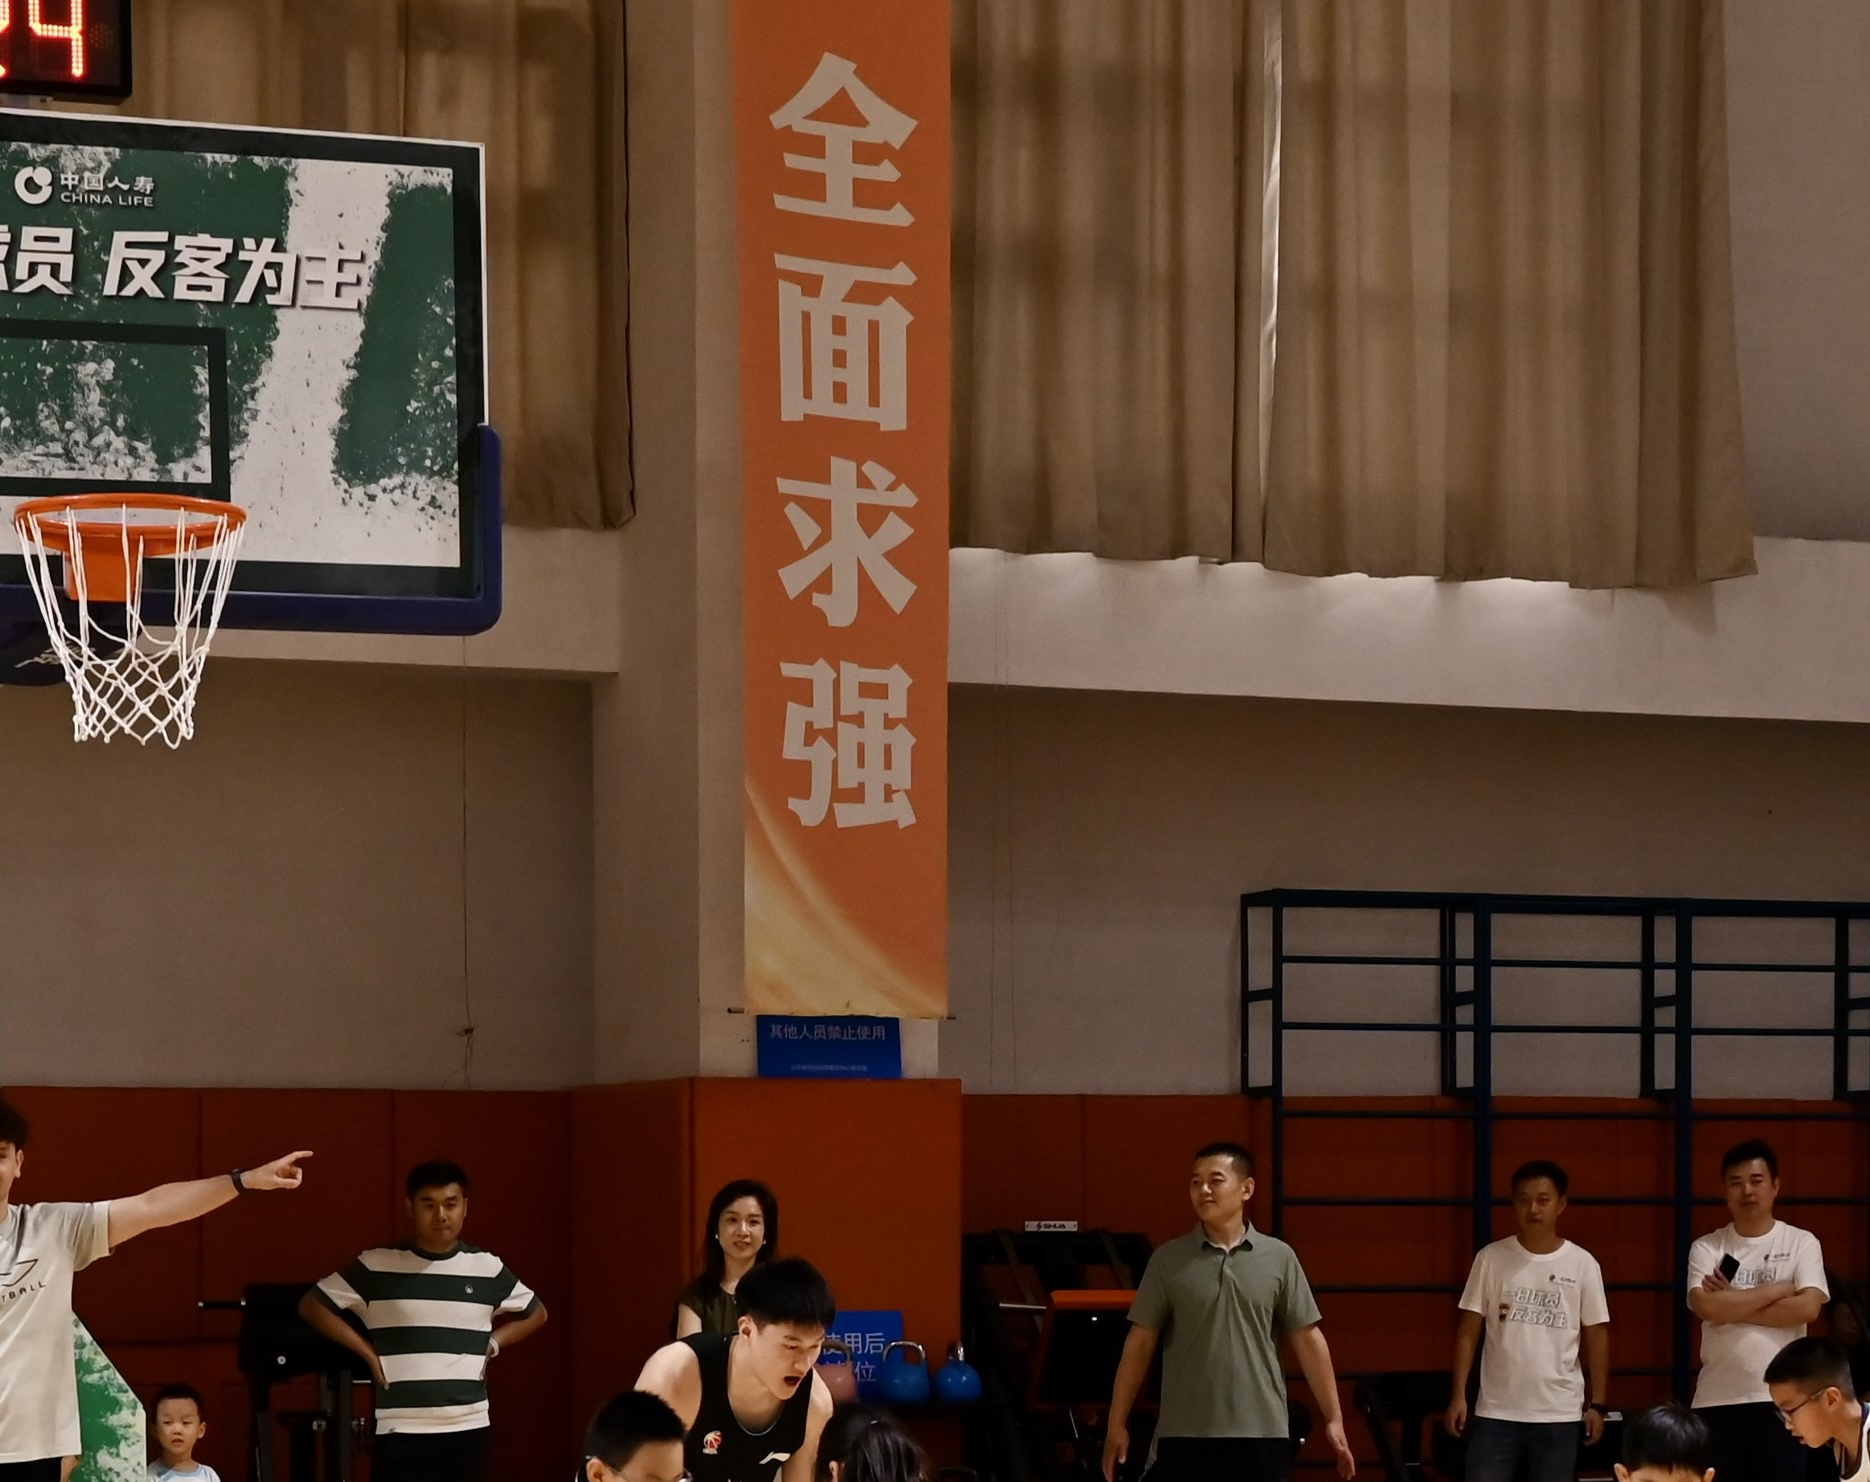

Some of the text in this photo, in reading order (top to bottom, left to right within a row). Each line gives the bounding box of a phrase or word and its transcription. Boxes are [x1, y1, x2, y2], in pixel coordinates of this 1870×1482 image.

[61, 172, 155, 197] 中国人寿
[61, 192, 154, 207] CHINA LIFE
[102, 230, 366, 311] 反客为主
[769, 51, 919, 830] 全面求强
[769, 1024, 886, 1041] 其他人员禁止使用
